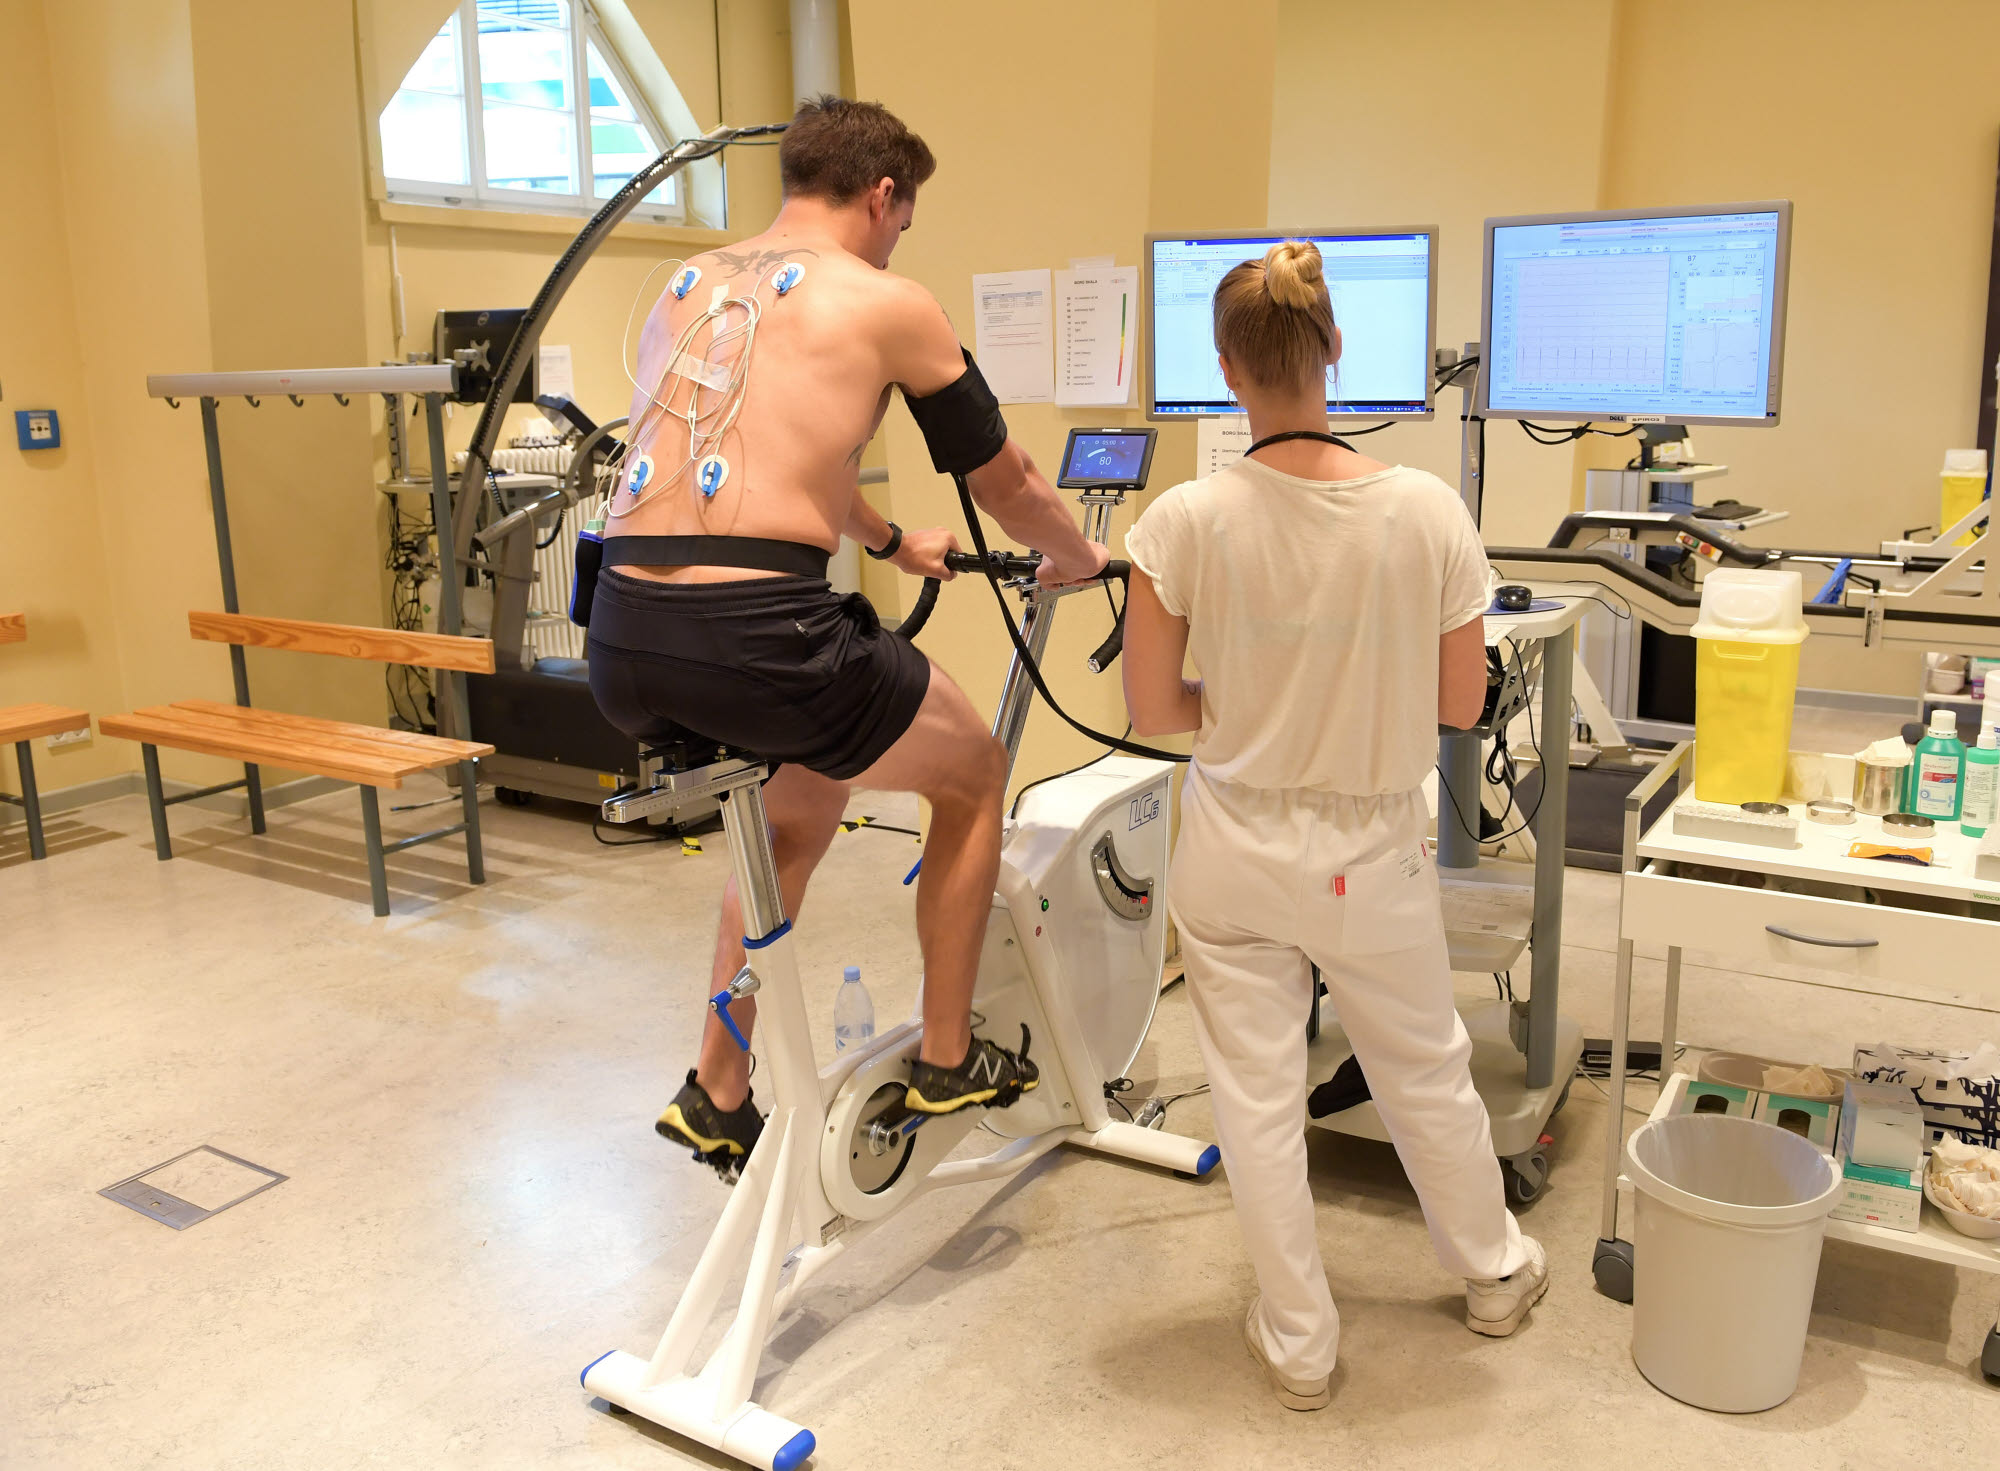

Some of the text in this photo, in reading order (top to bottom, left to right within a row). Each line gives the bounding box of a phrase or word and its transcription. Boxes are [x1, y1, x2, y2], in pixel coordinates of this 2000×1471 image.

[1099, 456, 1112, 466] 80
[1128, 791, 1160, 832] LC6
[969, 1050, 1002, 1086] N
